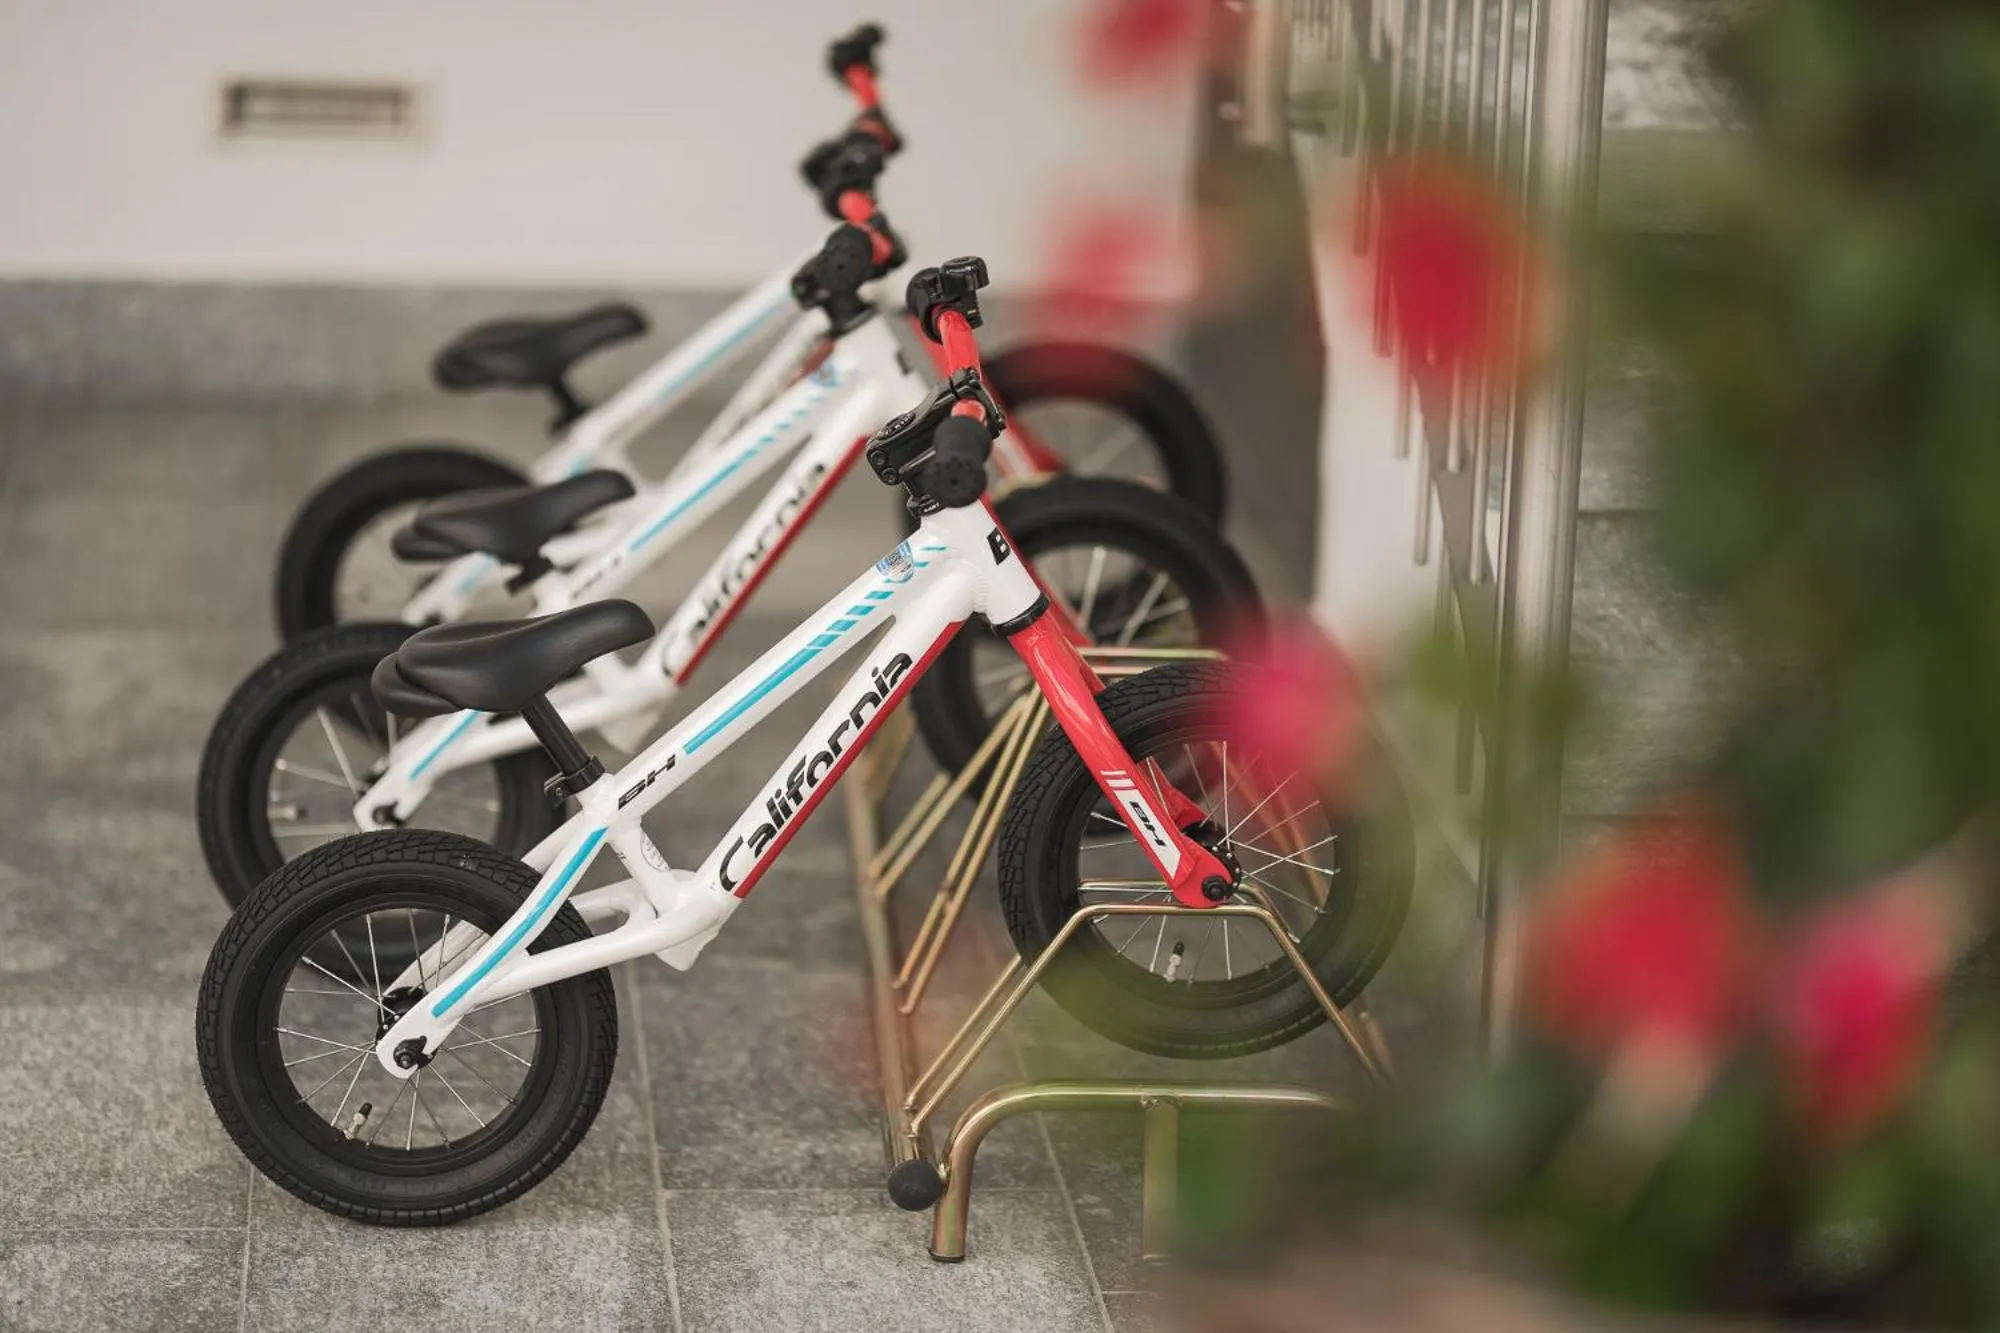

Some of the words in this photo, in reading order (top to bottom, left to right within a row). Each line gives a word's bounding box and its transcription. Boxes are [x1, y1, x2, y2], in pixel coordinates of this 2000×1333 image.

[618, 753, 676, 811] BH
[719, 651, 913, 892] California
[1129, 800, 1166, 848] BH
